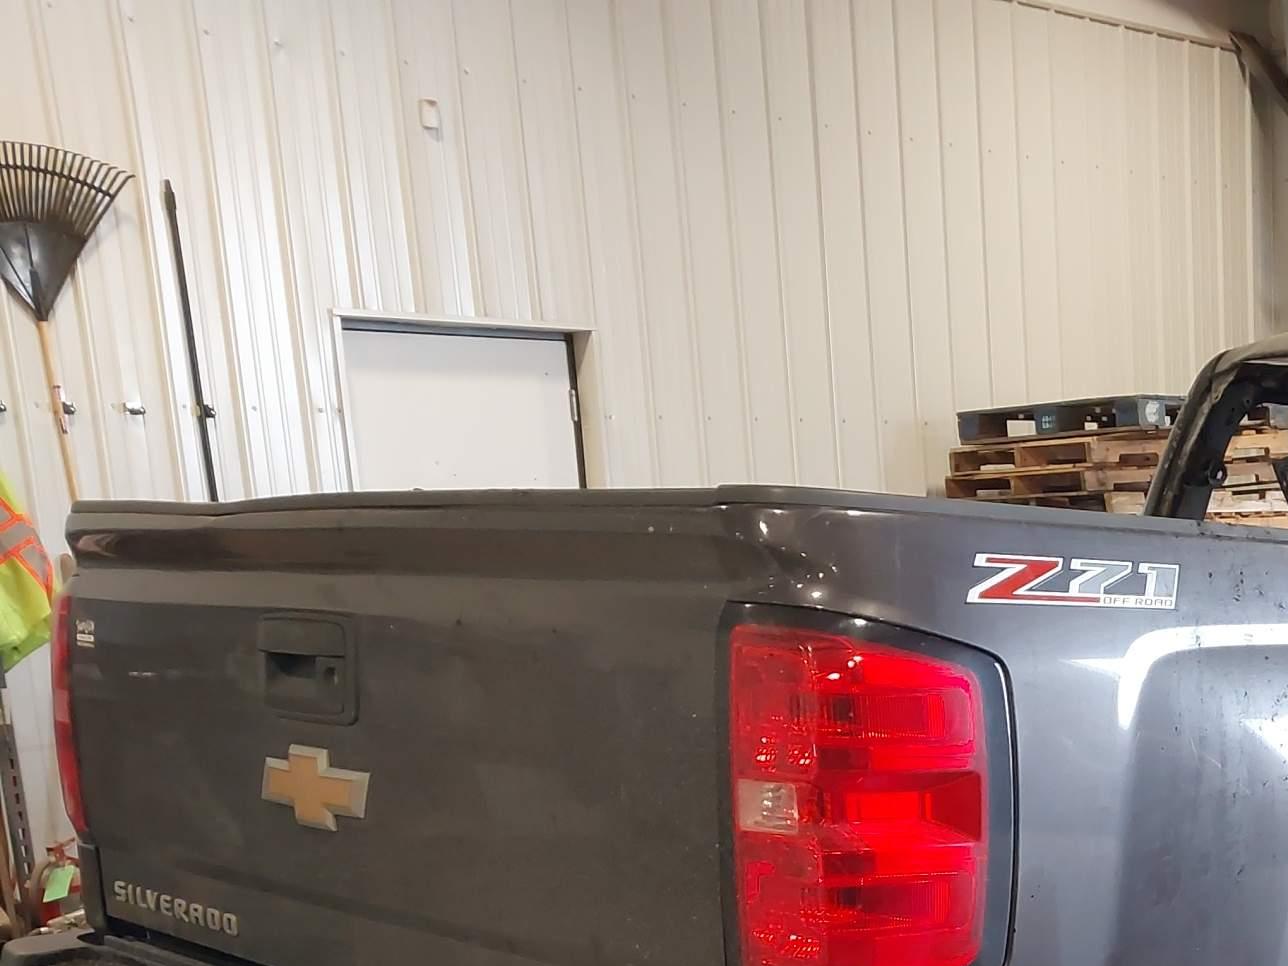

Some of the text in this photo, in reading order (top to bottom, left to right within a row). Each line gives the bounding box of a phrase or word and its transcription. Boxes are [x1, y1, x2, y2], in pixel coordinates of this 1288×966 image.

[966, 553, 1181, 610] Z71
[1102, 596, 1173, 607] OFF ROAD
[114, 880, 239, 937] SILVERADO
